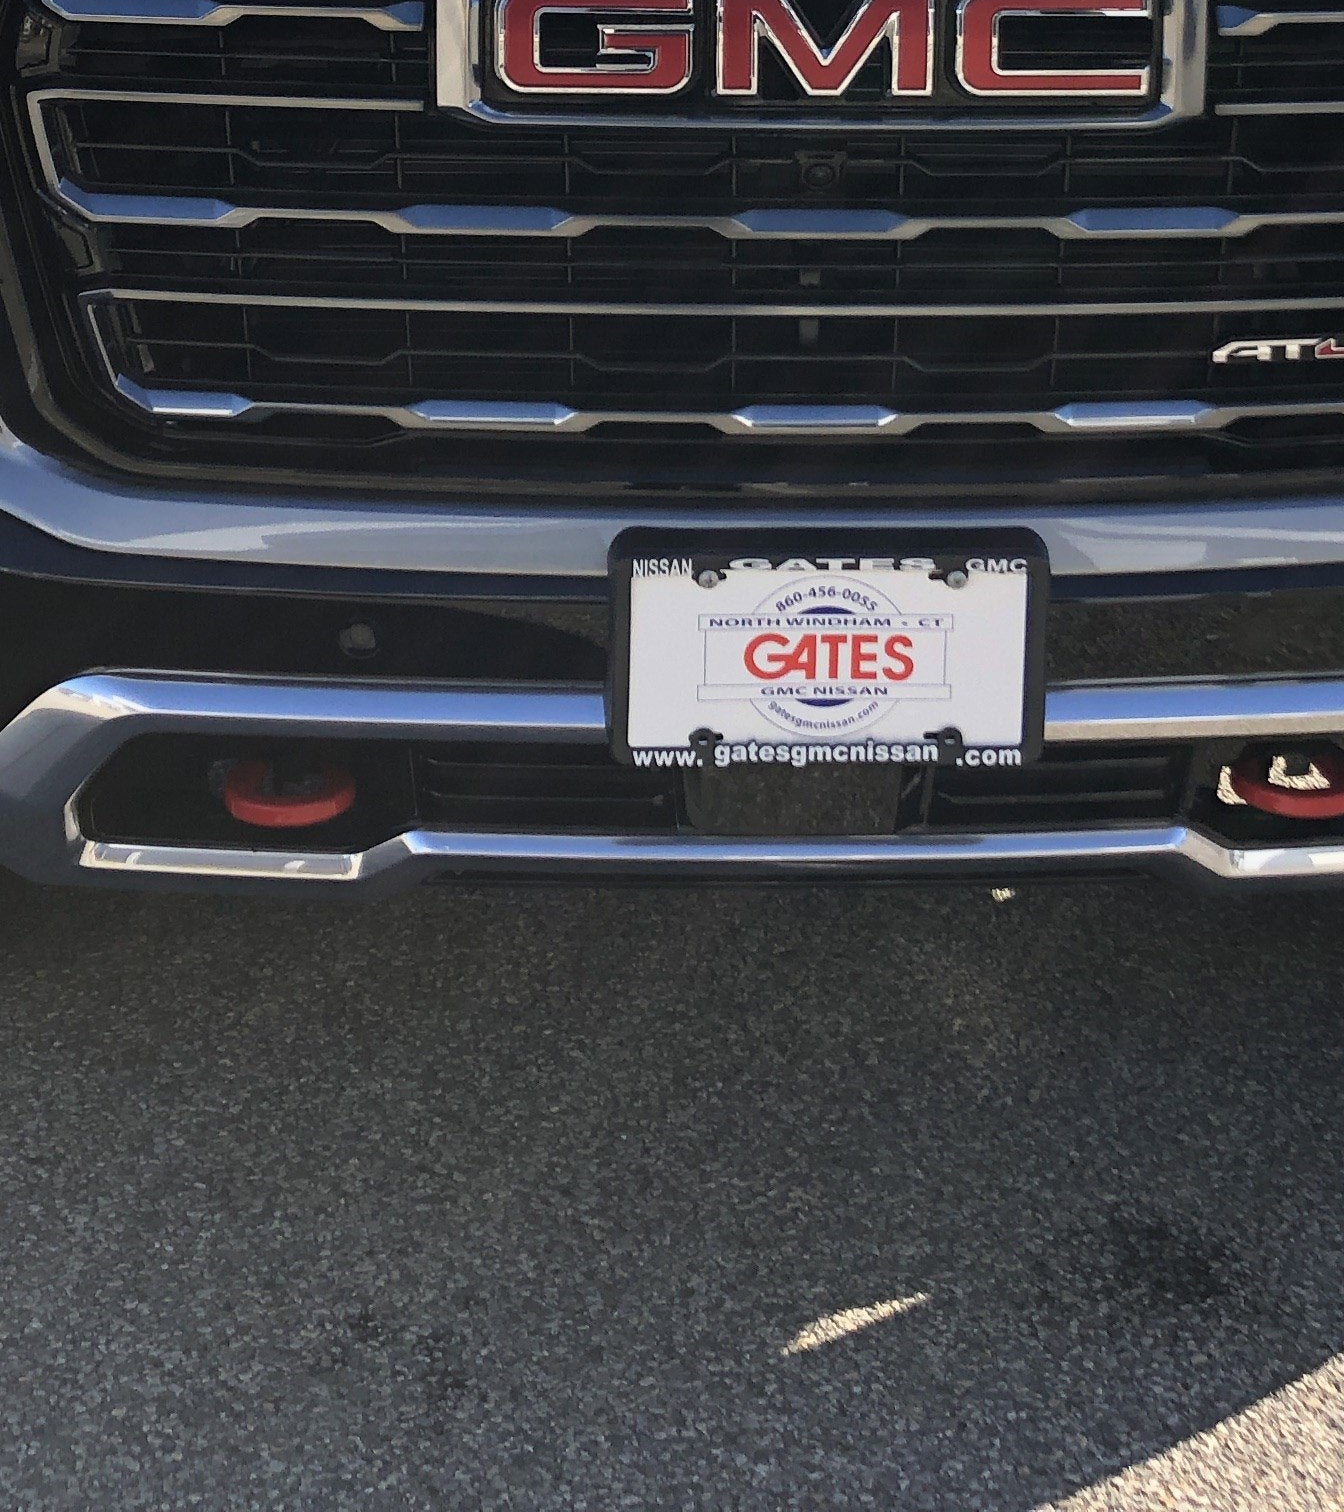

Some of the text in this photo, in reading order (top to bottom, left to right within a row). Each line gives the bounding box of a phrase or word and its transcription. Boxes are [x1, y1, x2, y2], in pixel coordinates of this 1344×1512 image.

[632, 558, 693, 577] NISSAN
[728, 557, 936, 571] GATES
[966, 558, 1027, 573] GMC
[775, 585, 878, 612] 860-456-0055
[709, 617, 944, 626] NORTH WINDHAM CT
[743, 632, 914, 681] GATES
[760, 686, 888, 695] GMC NISSAN
[768, 700, 879, 729] gatesgmcnissan.com
[632, 740, 1022, 768] www. gatesgmcnissan .com
